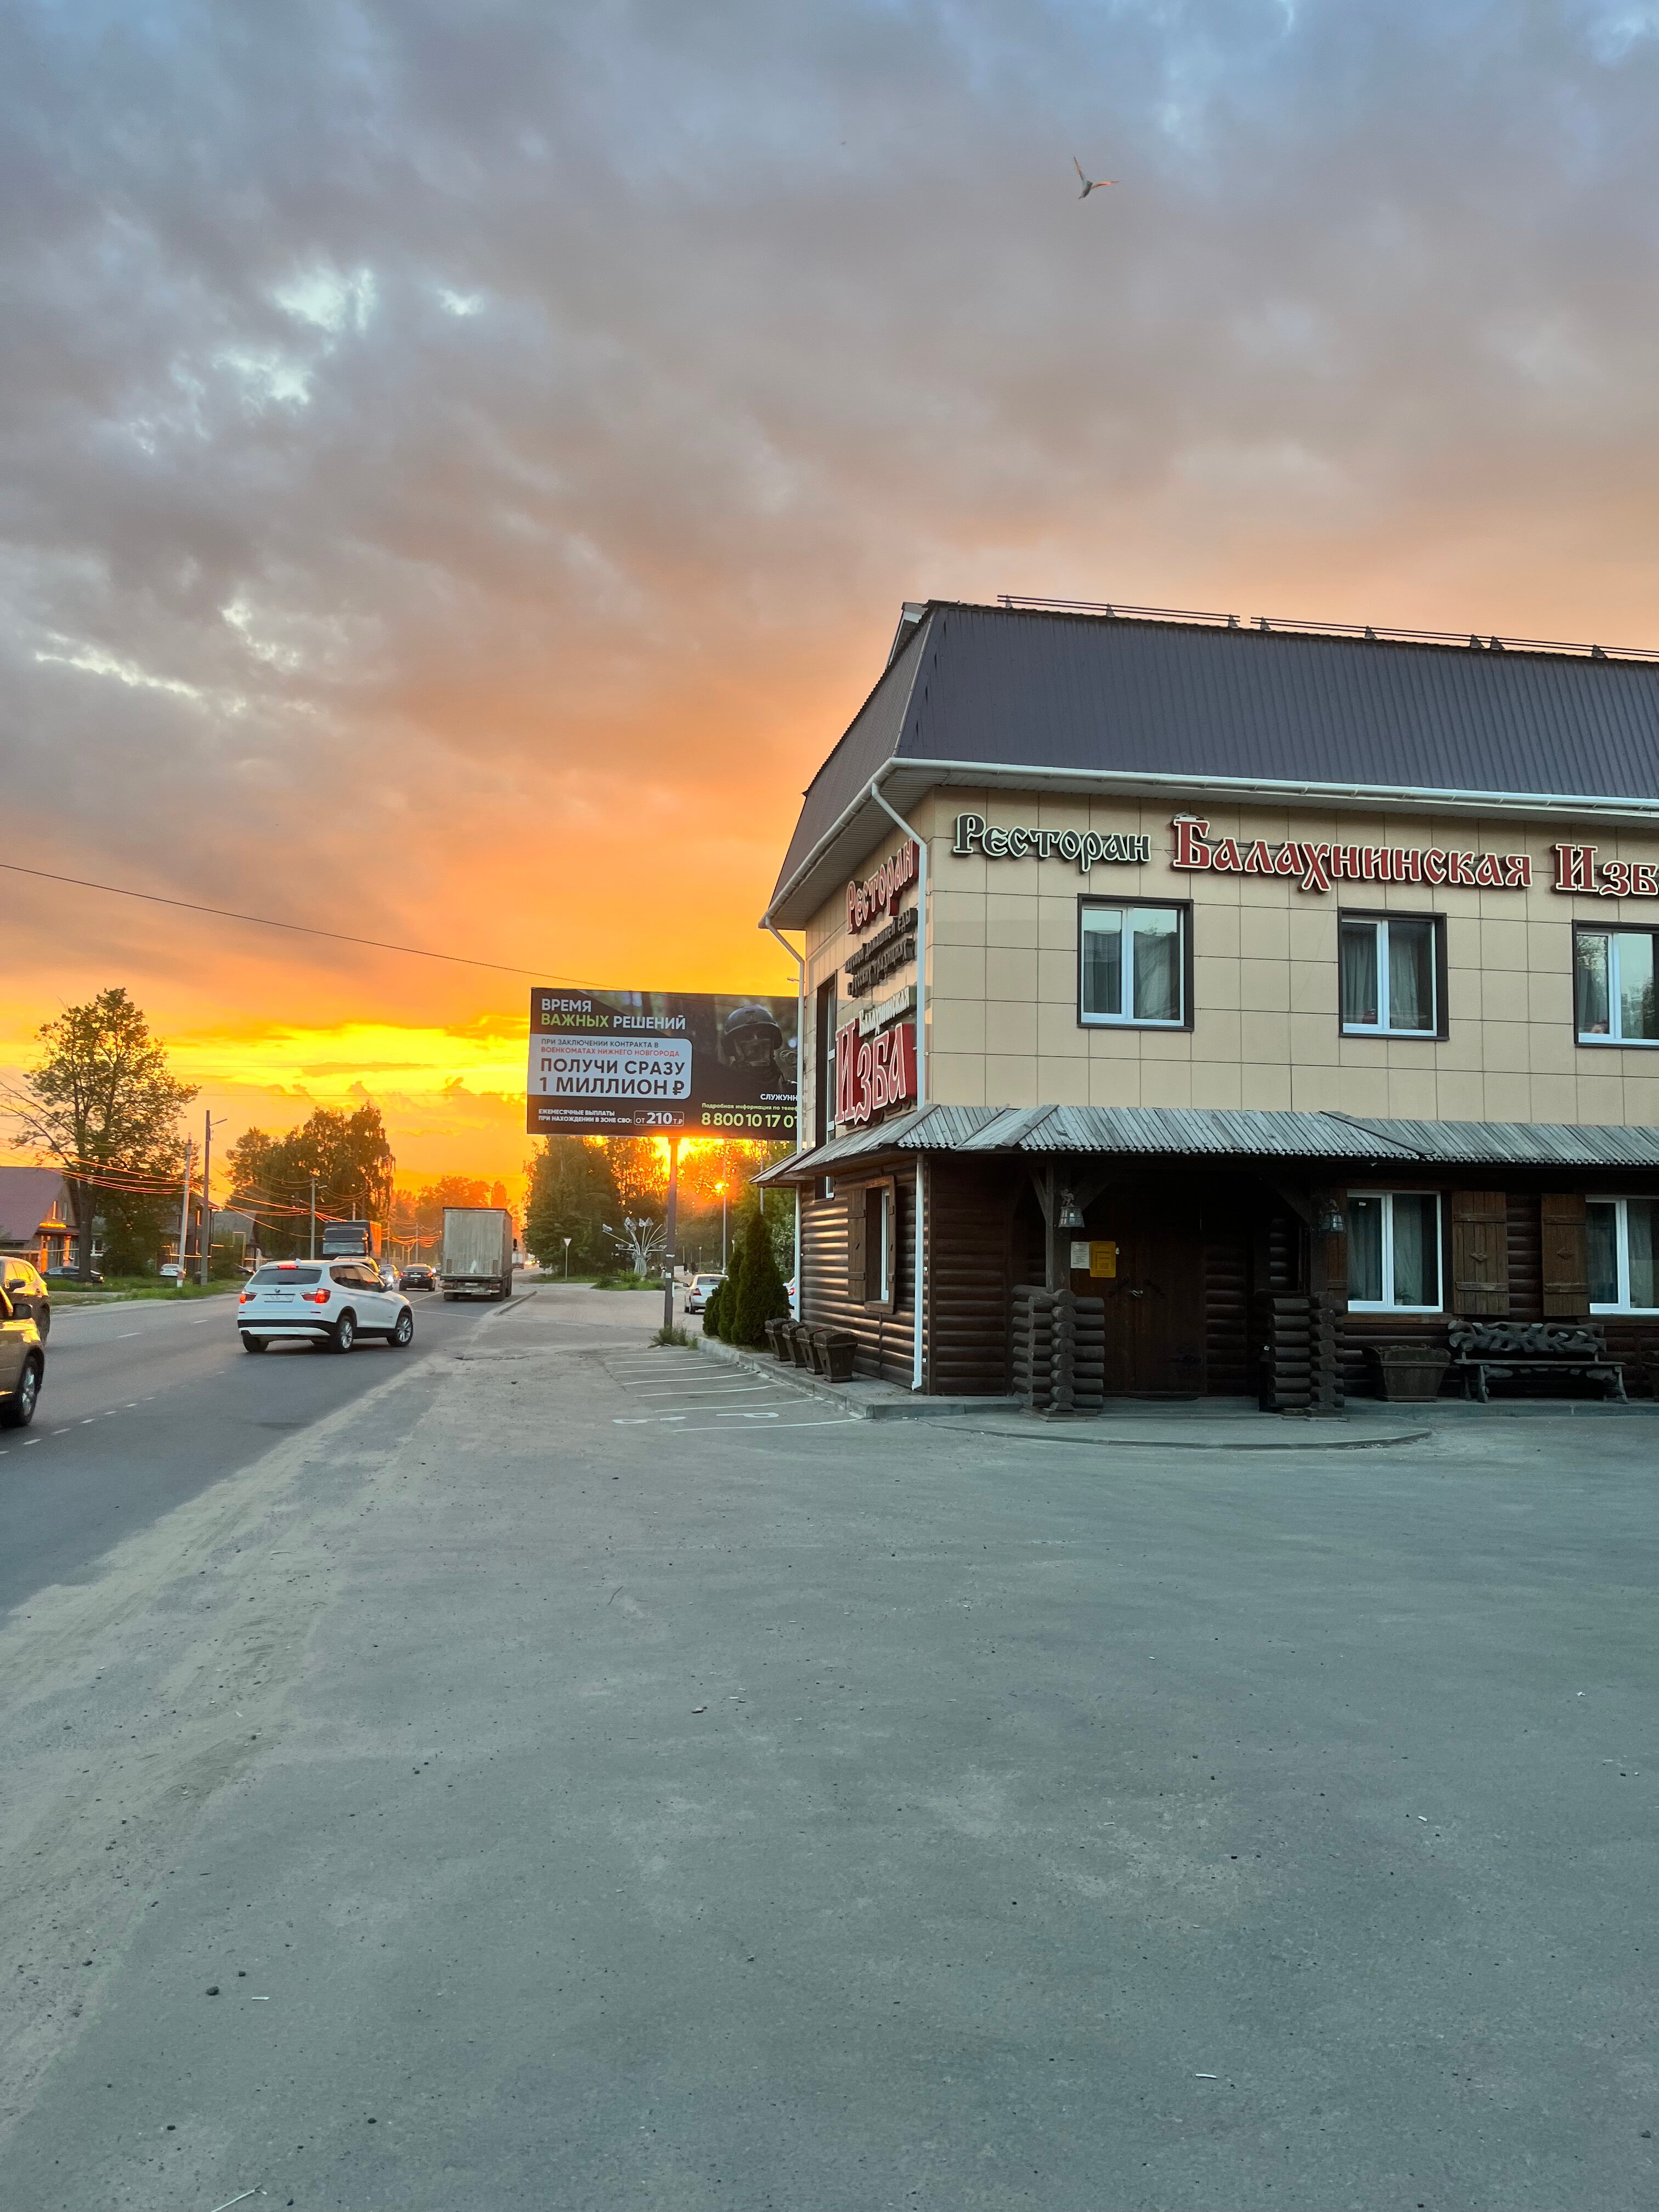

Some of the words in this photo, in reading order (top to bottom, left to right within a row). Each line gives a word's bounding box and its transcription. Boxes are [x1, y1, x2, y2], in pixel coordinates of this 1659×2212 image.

[953, 812, 1151, 873] Ресторан
[1173, 819, 1533, 891] Балахнинская
[846, 837, 914, 933] Ресторан
[541, 998, 592, 1013] ВРЕМЯ
[541, 1013, 609, 1028] ВАЖНЫХ
[613, 1015, 686, 1030] РЕШЕНИЙ
[541, 1058, 618, 1074] ПОЛУЧИ
[624, 1060, 685, 1075] СРАЗУ
[834, 1022, 906, 1125] Изба
[539, 1077, 547, 1092] 1
[556, 1077, 667, 1095] МИЛЛИОН
[646, 1112, 673, 1125] 210
[701, 1112, 711, 1126] 8
[713, 1113, 744, 1126] 800
[746, 1114, 762, 1127] 10
[765, 1114, 781, 1127] 17
